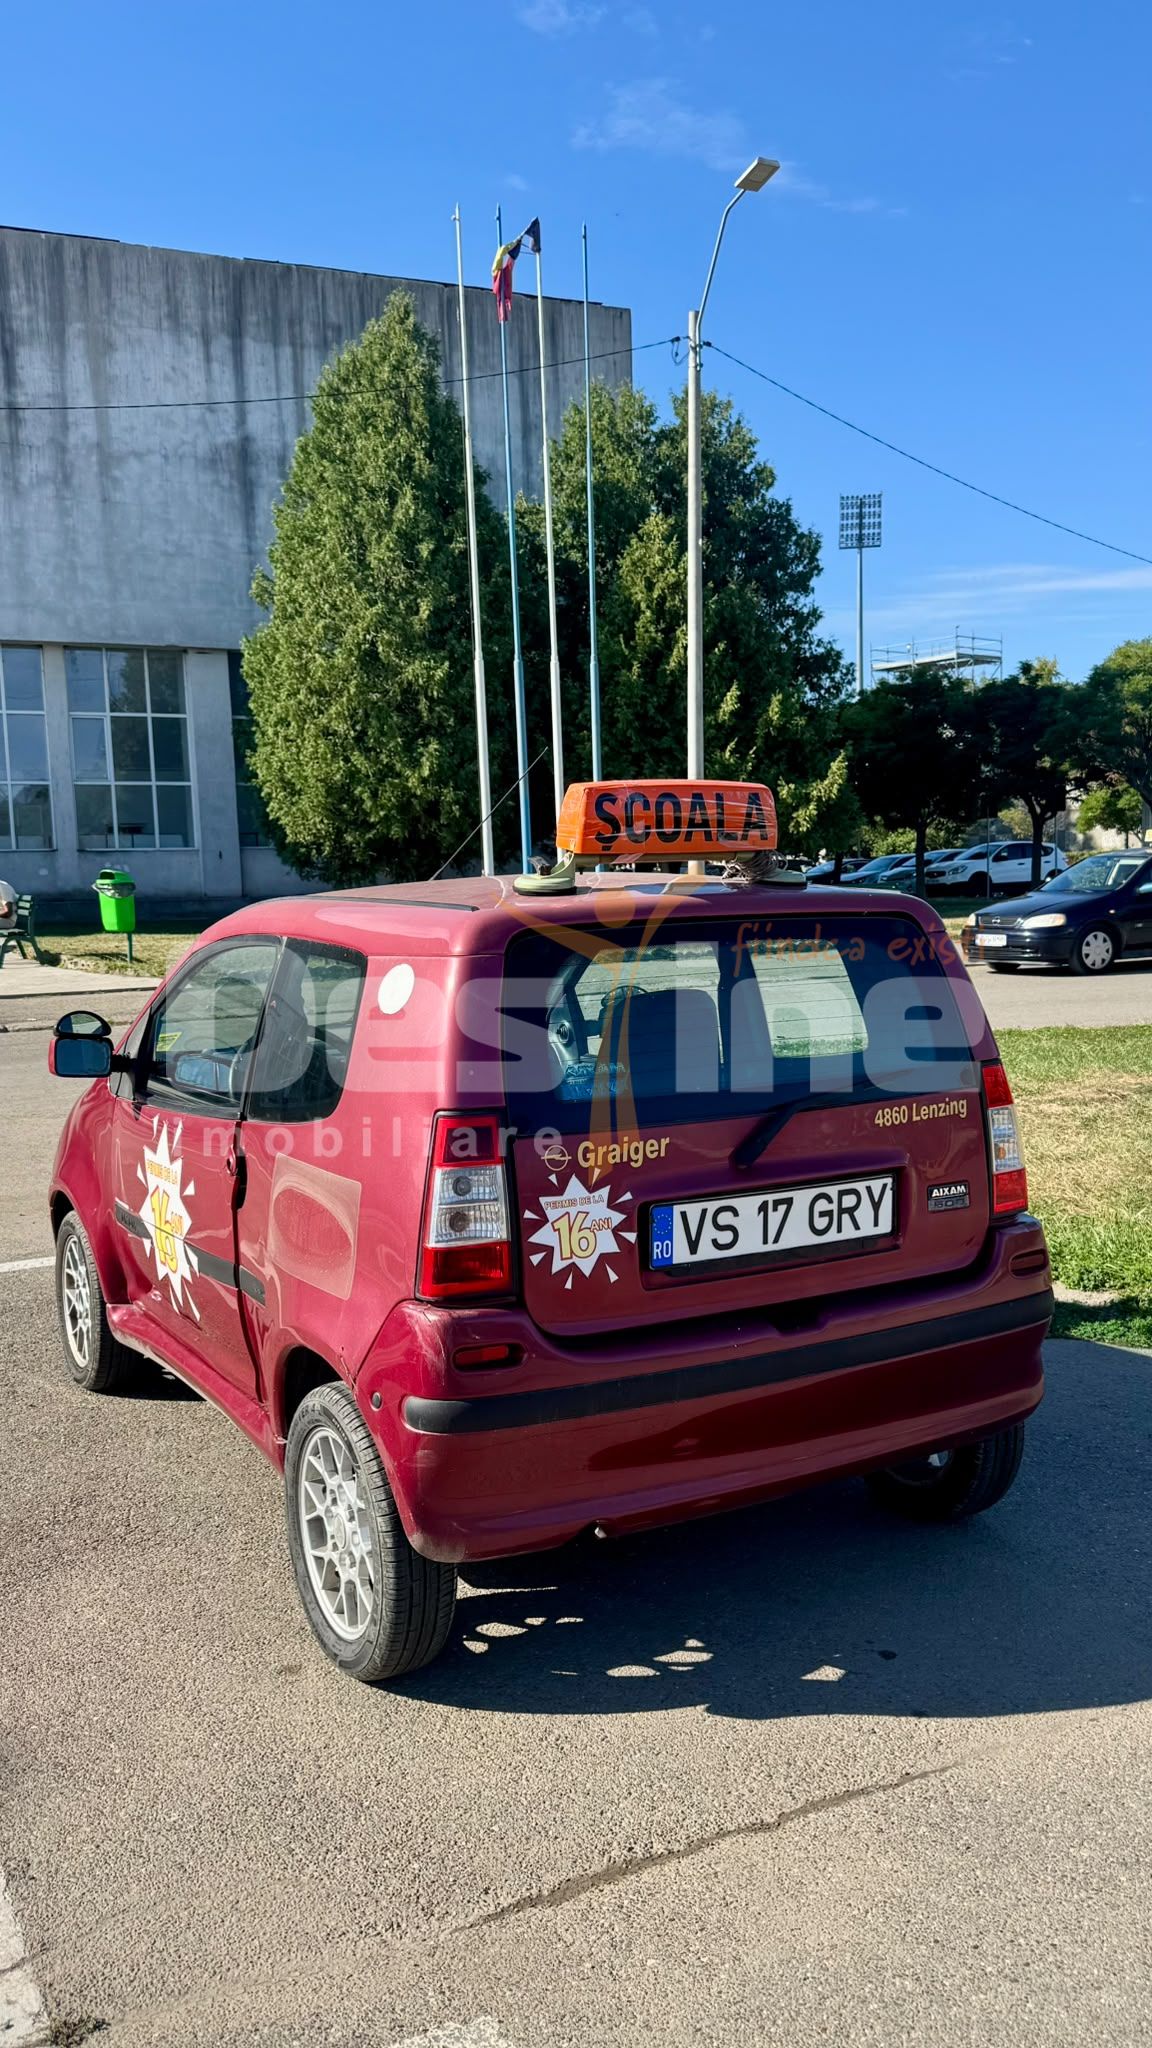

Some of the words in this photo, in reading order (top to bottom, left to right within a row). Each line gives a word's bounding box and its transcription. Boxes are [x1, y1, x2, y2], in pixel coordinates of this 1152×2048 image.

[874, 1105, 908, 1128] 4860
[912, 1097, 968, 1121] Lenzing
[577, 1136, 670, 1168] Graiger
[544, 1196, 578, 1211] PERMIS
[578, 1196, 591, 1207] DE
[592, 1193, 604, 1205] LA
[931, 1184, 967, 1198] AIXAM
[552, 1211, 597, 1261] 16
[590, 1216, 613, 1233] ANI
[653, 1240, 672, 1260] RO
[680, 1205, 740, 1255] VS
[757, 1197, 794, 1245] 17
[808, 1183, 888, 1236] GRY
